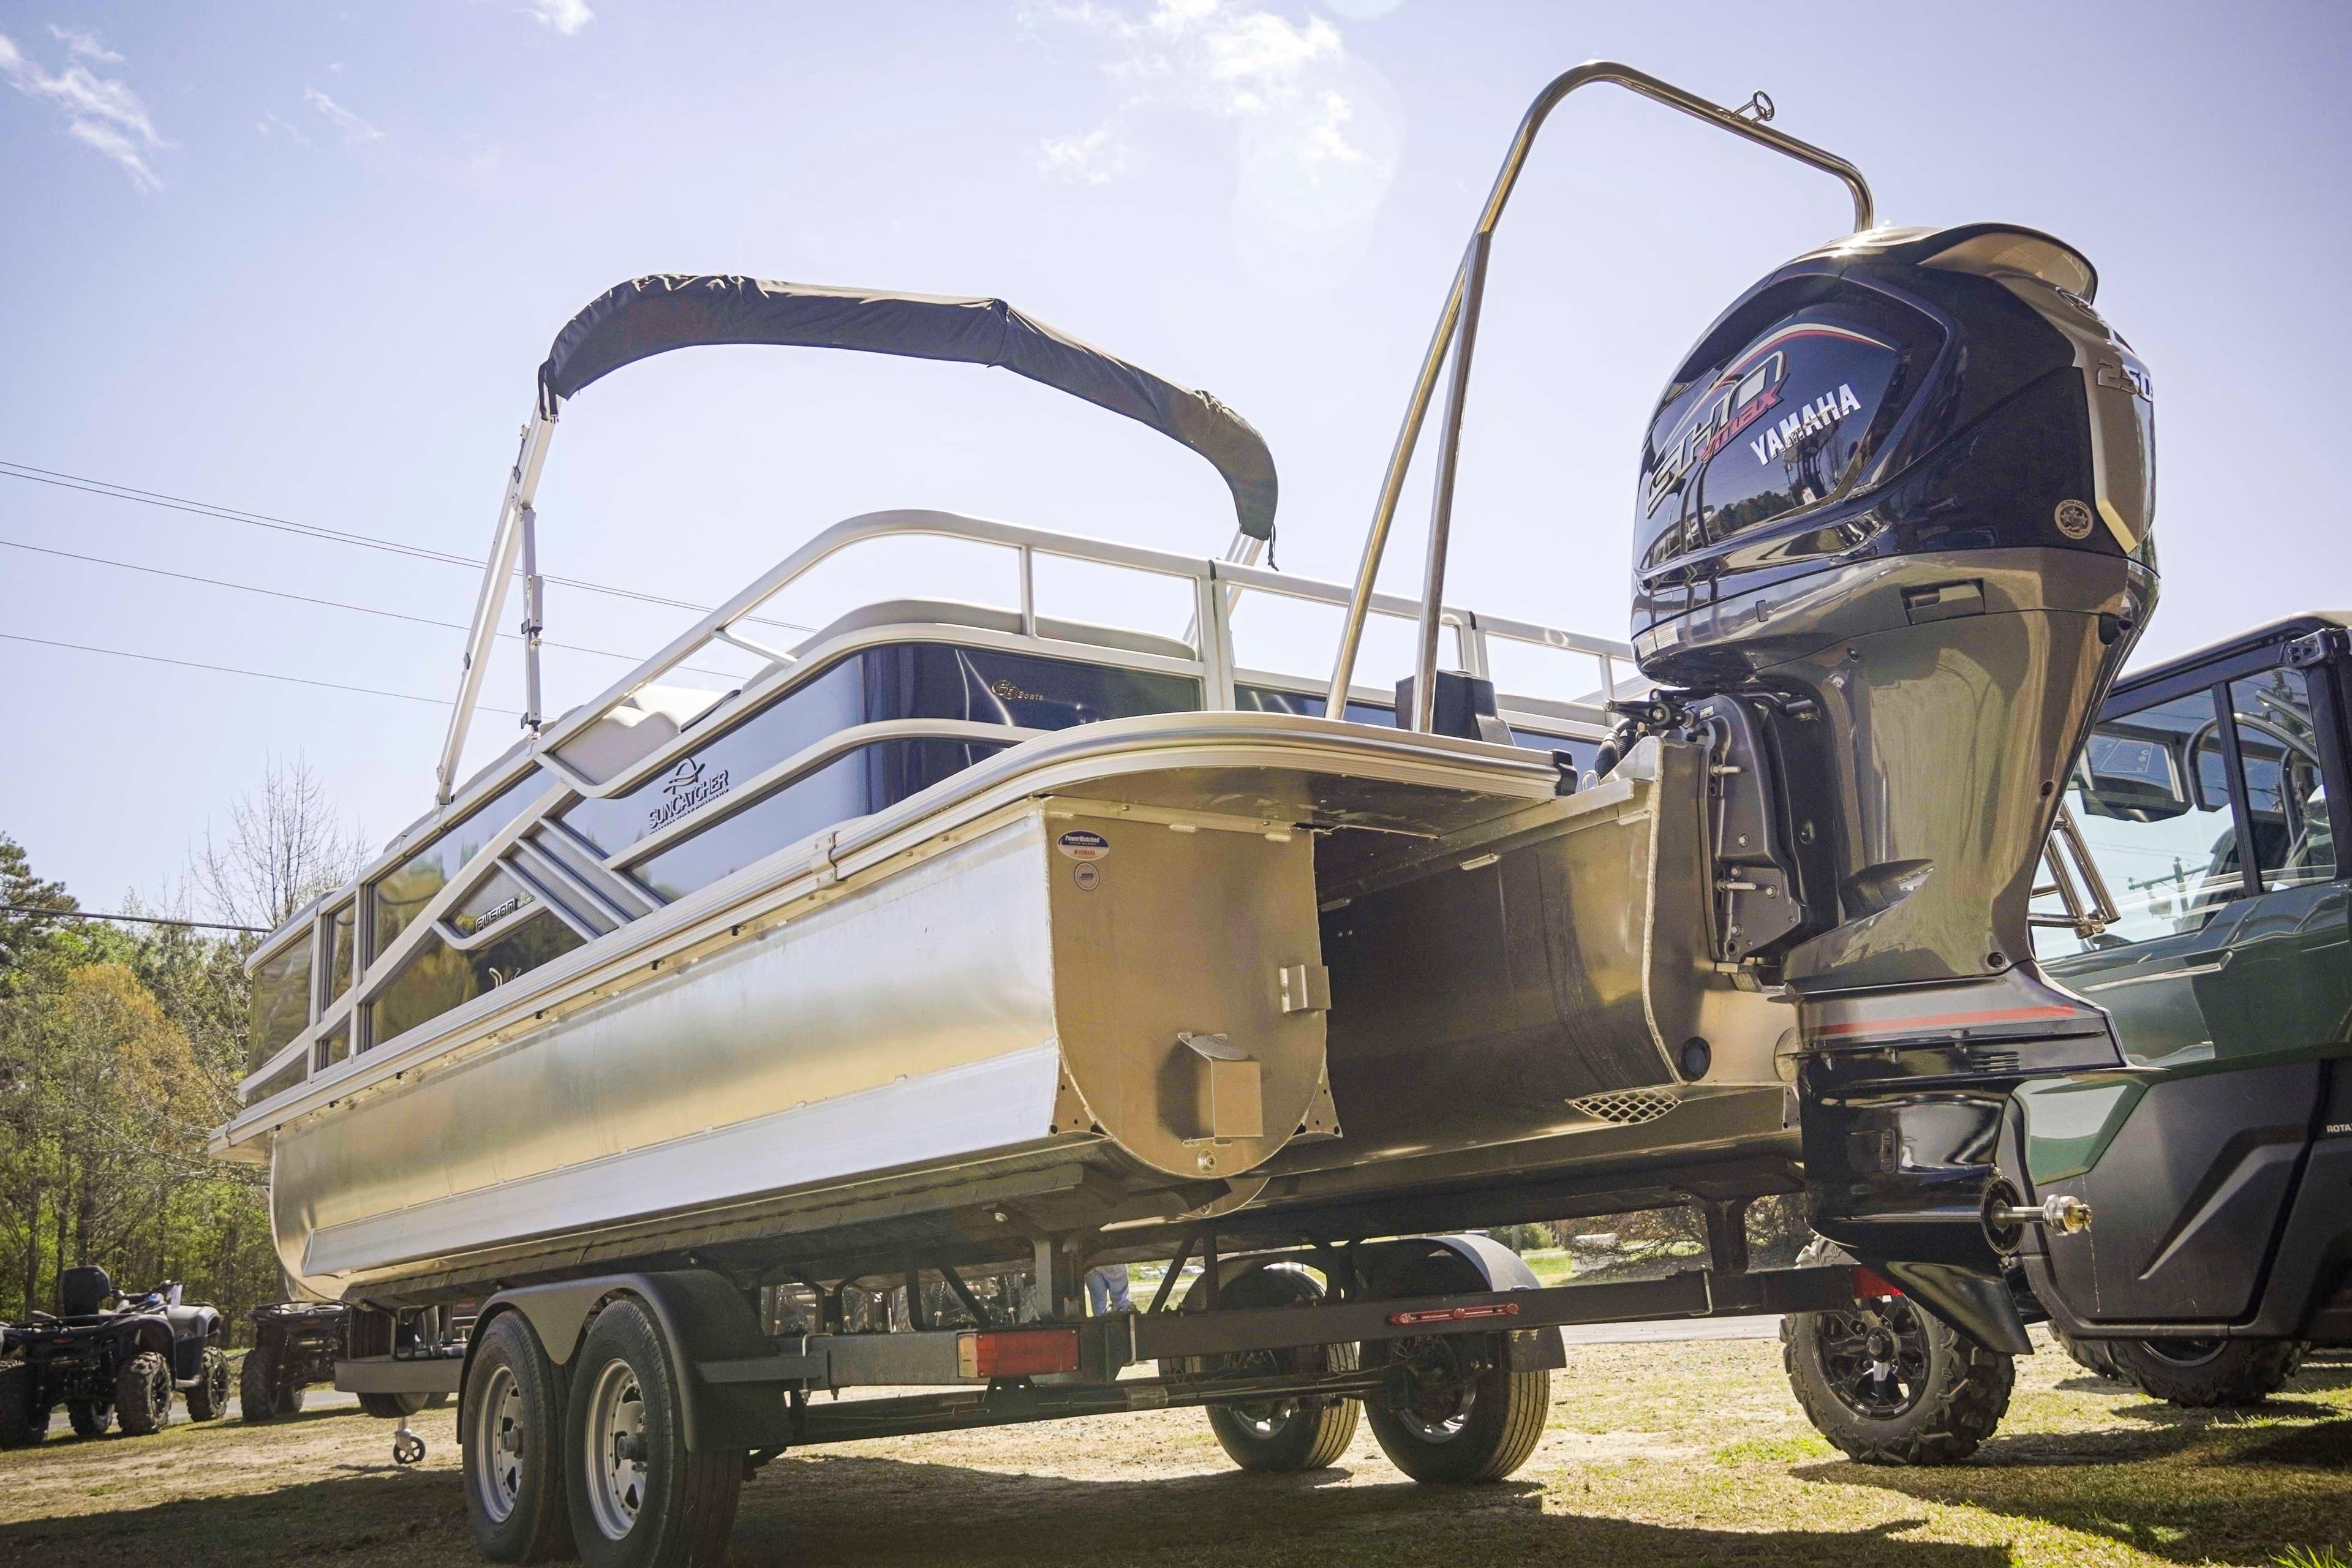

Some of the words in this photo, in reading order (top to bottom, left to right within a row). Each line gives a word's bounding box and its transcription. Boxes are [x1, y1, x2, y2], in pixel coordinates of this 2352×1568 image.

[1750, 383, 1862, 466] YAMAHA
[649, 769, 729, 829] SUNCATCHER
[476, 898, 518, 932] FUSION
[2326, 1123, 2352, 1133] ROTA
